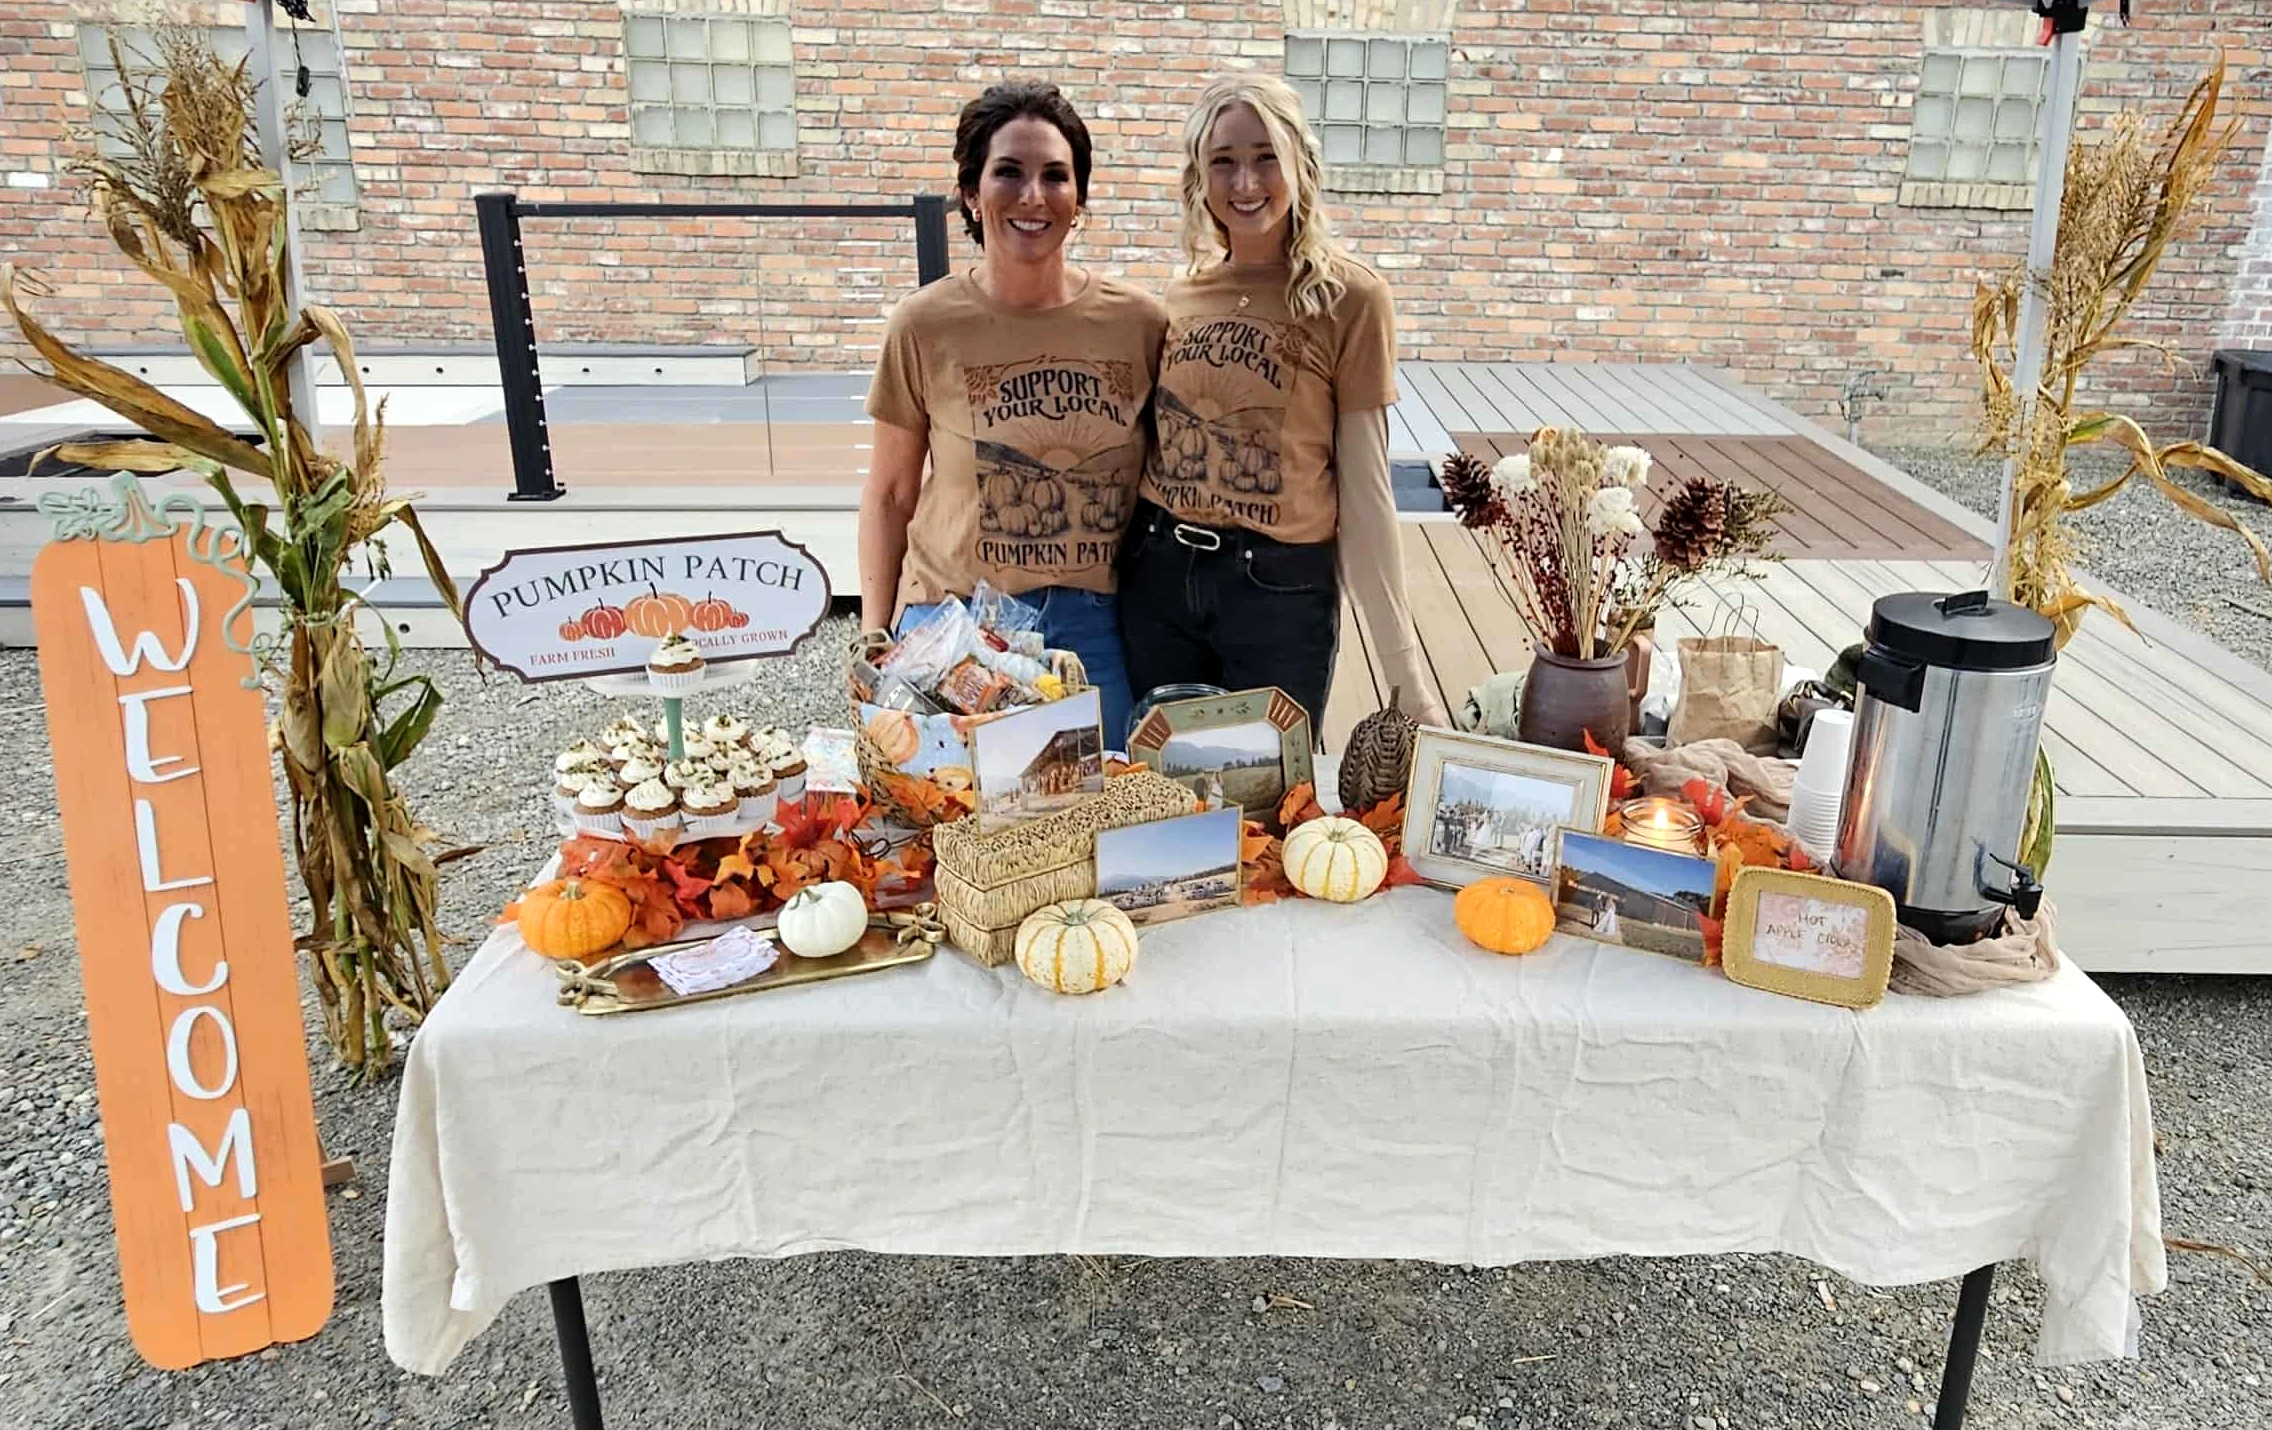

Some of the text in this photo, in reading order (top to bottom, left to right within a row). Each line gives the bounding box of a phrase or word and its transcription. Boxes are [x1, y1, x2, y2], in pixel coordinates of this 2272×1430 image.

[1182, 321, 1272, 354] SUPPORT
[1219, 345, 1282, 390] LOCAL
[999, 368, 1103, 404] SUPPORT
[983, 395, 1128, 429] YOUR LOCAL
[982, 541, 1068, 567] PUMPKIN
[490, 554, 806, 619] PUMPKIN PATCH
[530, 646, 616, 666] FARM FRESH
[692, 630, 789, 649] OCALLY GROWN
[1765, 923, 1806, 940] APPLE
[1797, 912, 1828, 927] HOT
[80, 576, 265, 1314] WELCOME
